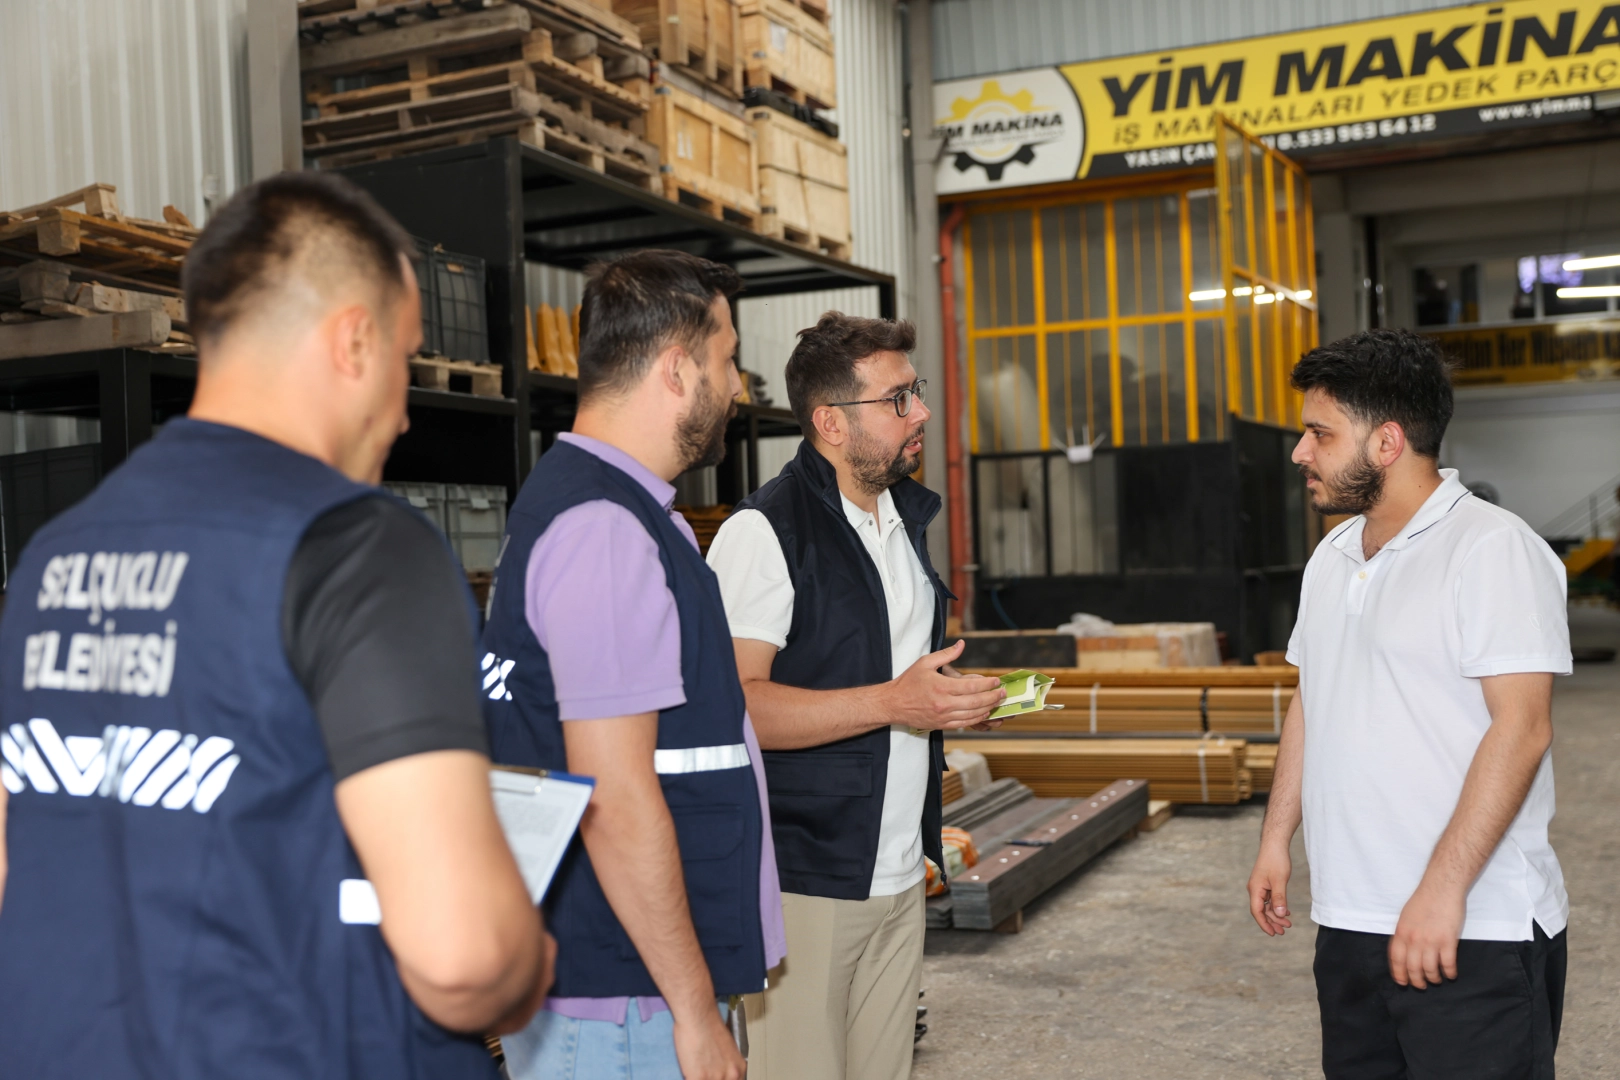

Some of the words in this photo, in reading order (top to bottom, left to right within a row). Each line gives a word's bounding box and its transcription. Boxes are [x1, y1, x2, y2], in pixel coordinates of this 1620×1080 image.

[1100, 57, 1246, 118] YİM
[1272, 6, 1620, 98] MAKİNA
[1380, 73, 1498, 111] YEDEK
[971, 113, 1062, 137] MAKİNA
